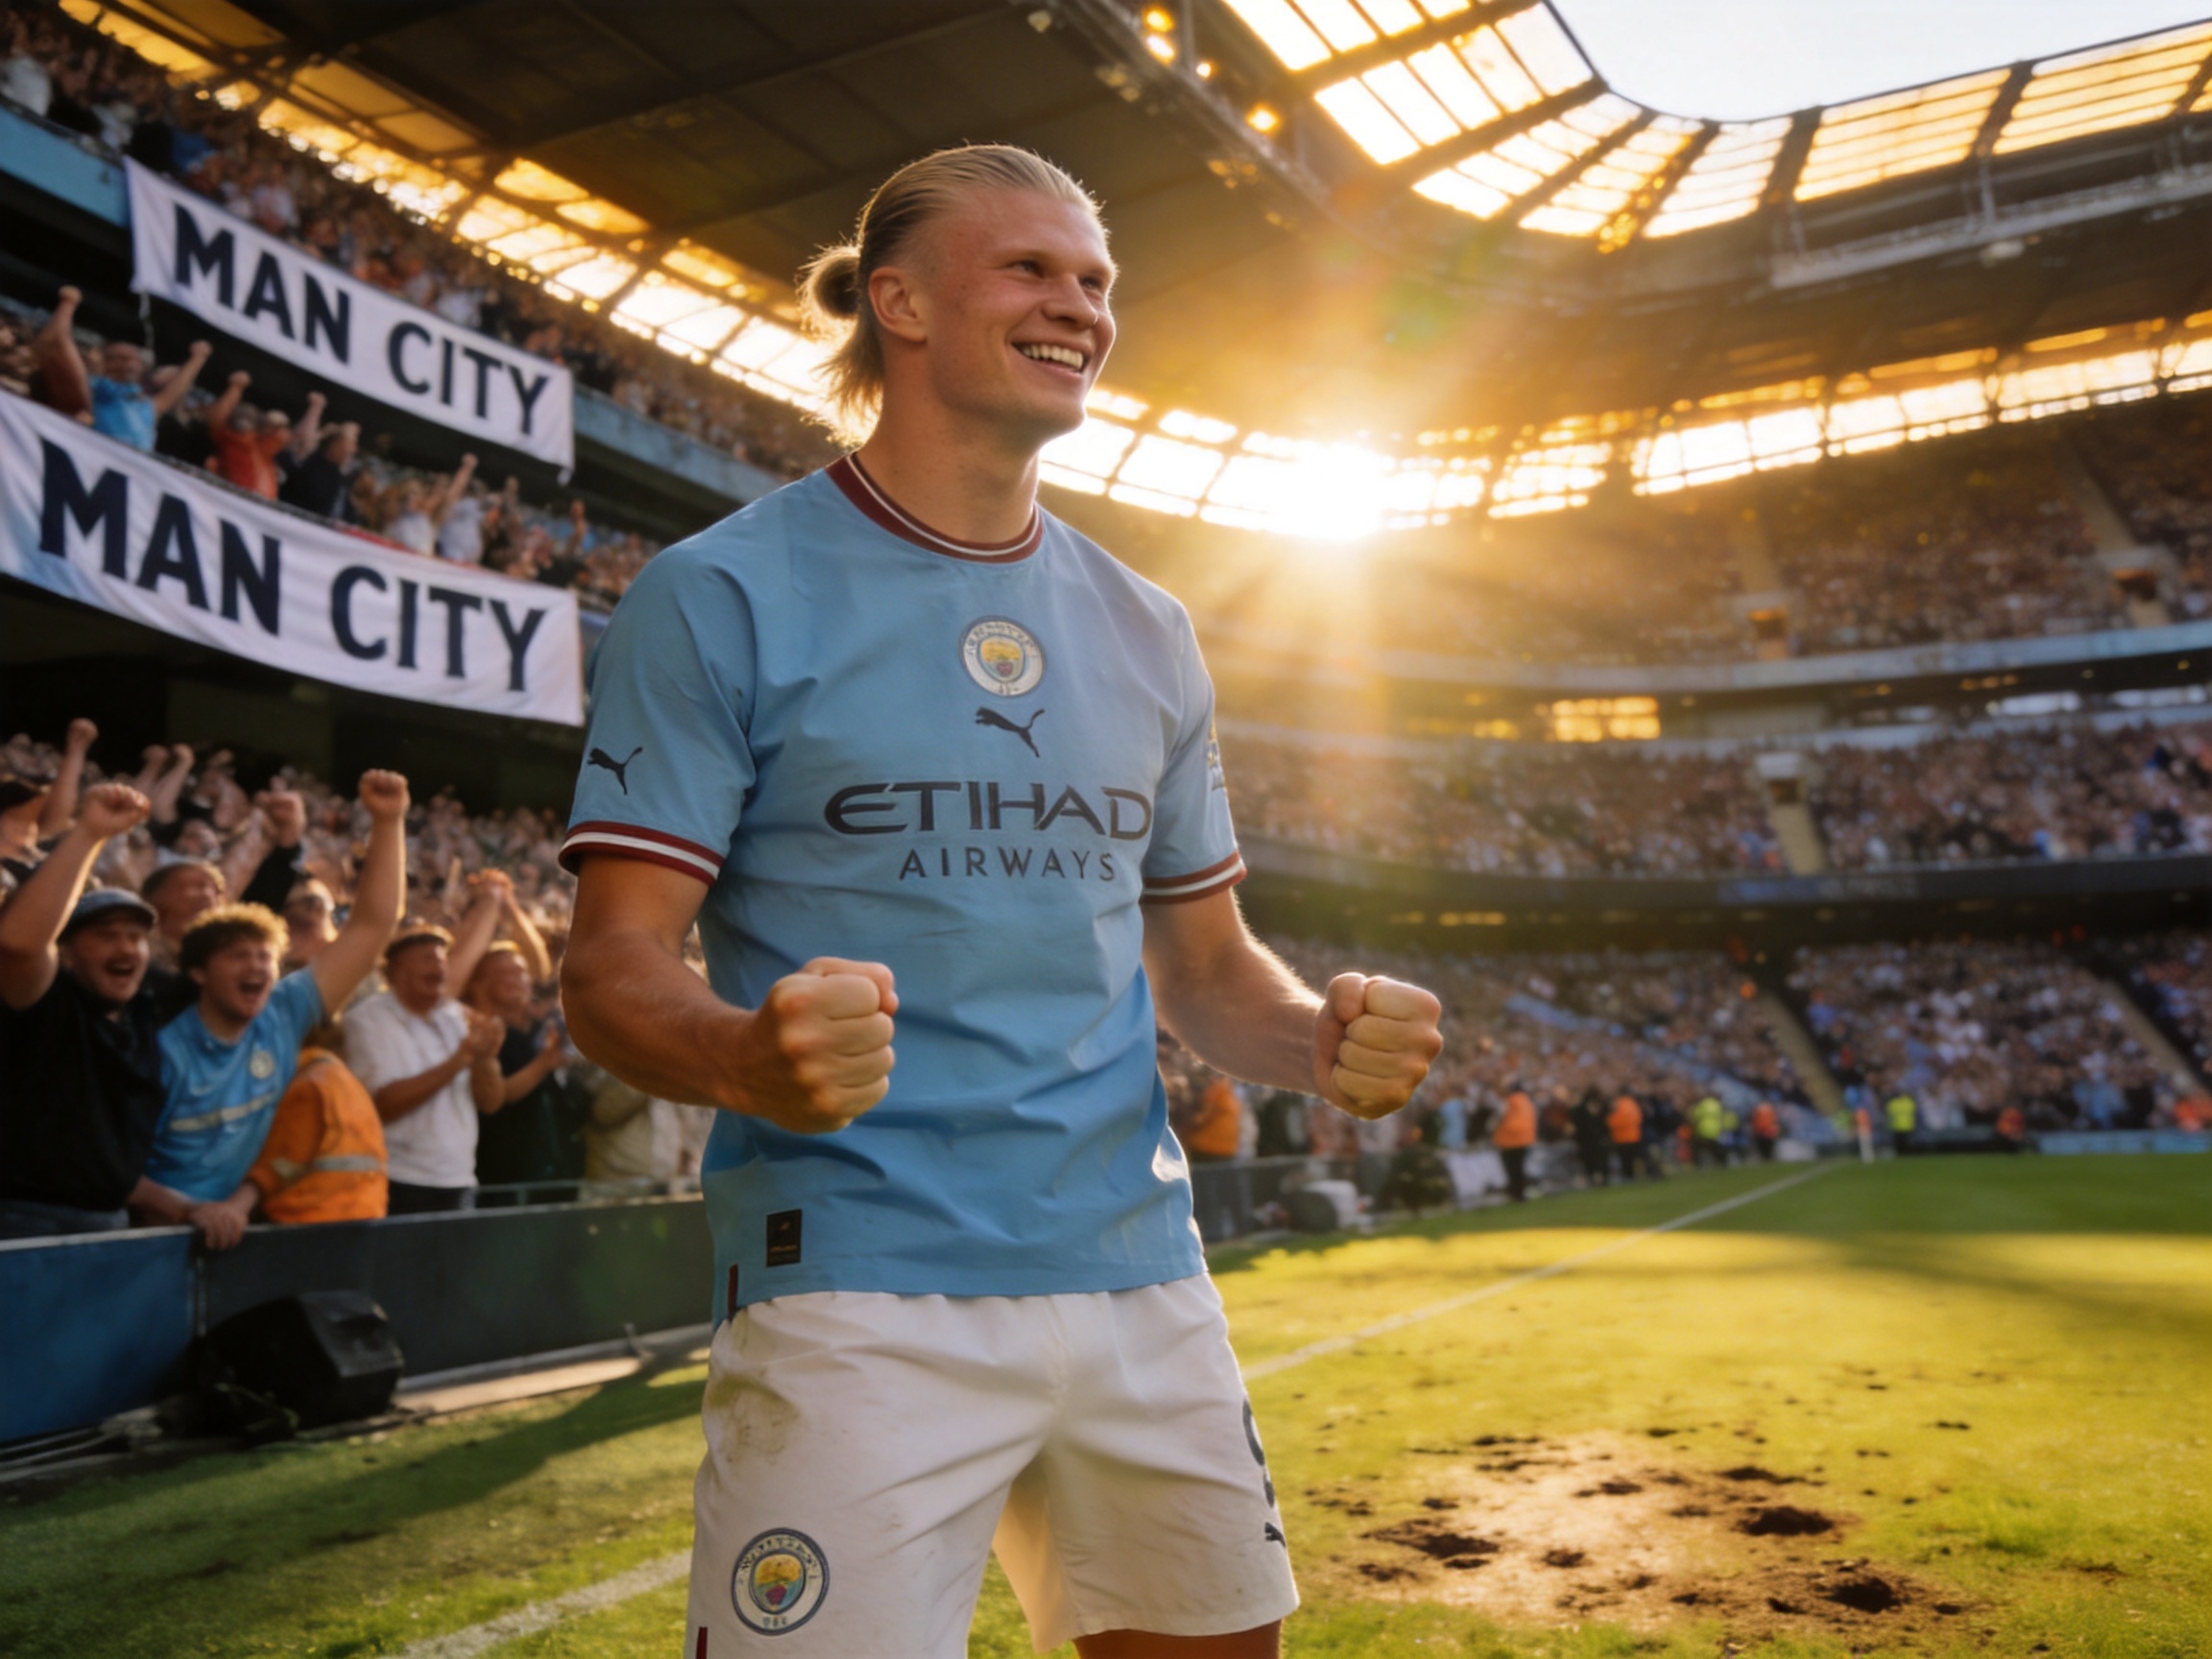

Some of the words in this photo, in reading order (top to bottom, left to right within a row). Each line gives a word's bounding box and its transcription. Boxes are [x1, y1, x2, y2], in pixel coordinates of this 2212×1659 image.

[172, 201, 351, 366] MAN
[387, 320, 549, 437] CITY
[39, 434, 281, 637] MAN
[329, 565, 547, 693] CITY
[823, 780, 1152, 841] ETIHAD
[898, 846, 1116, 881] AIRWAYS
